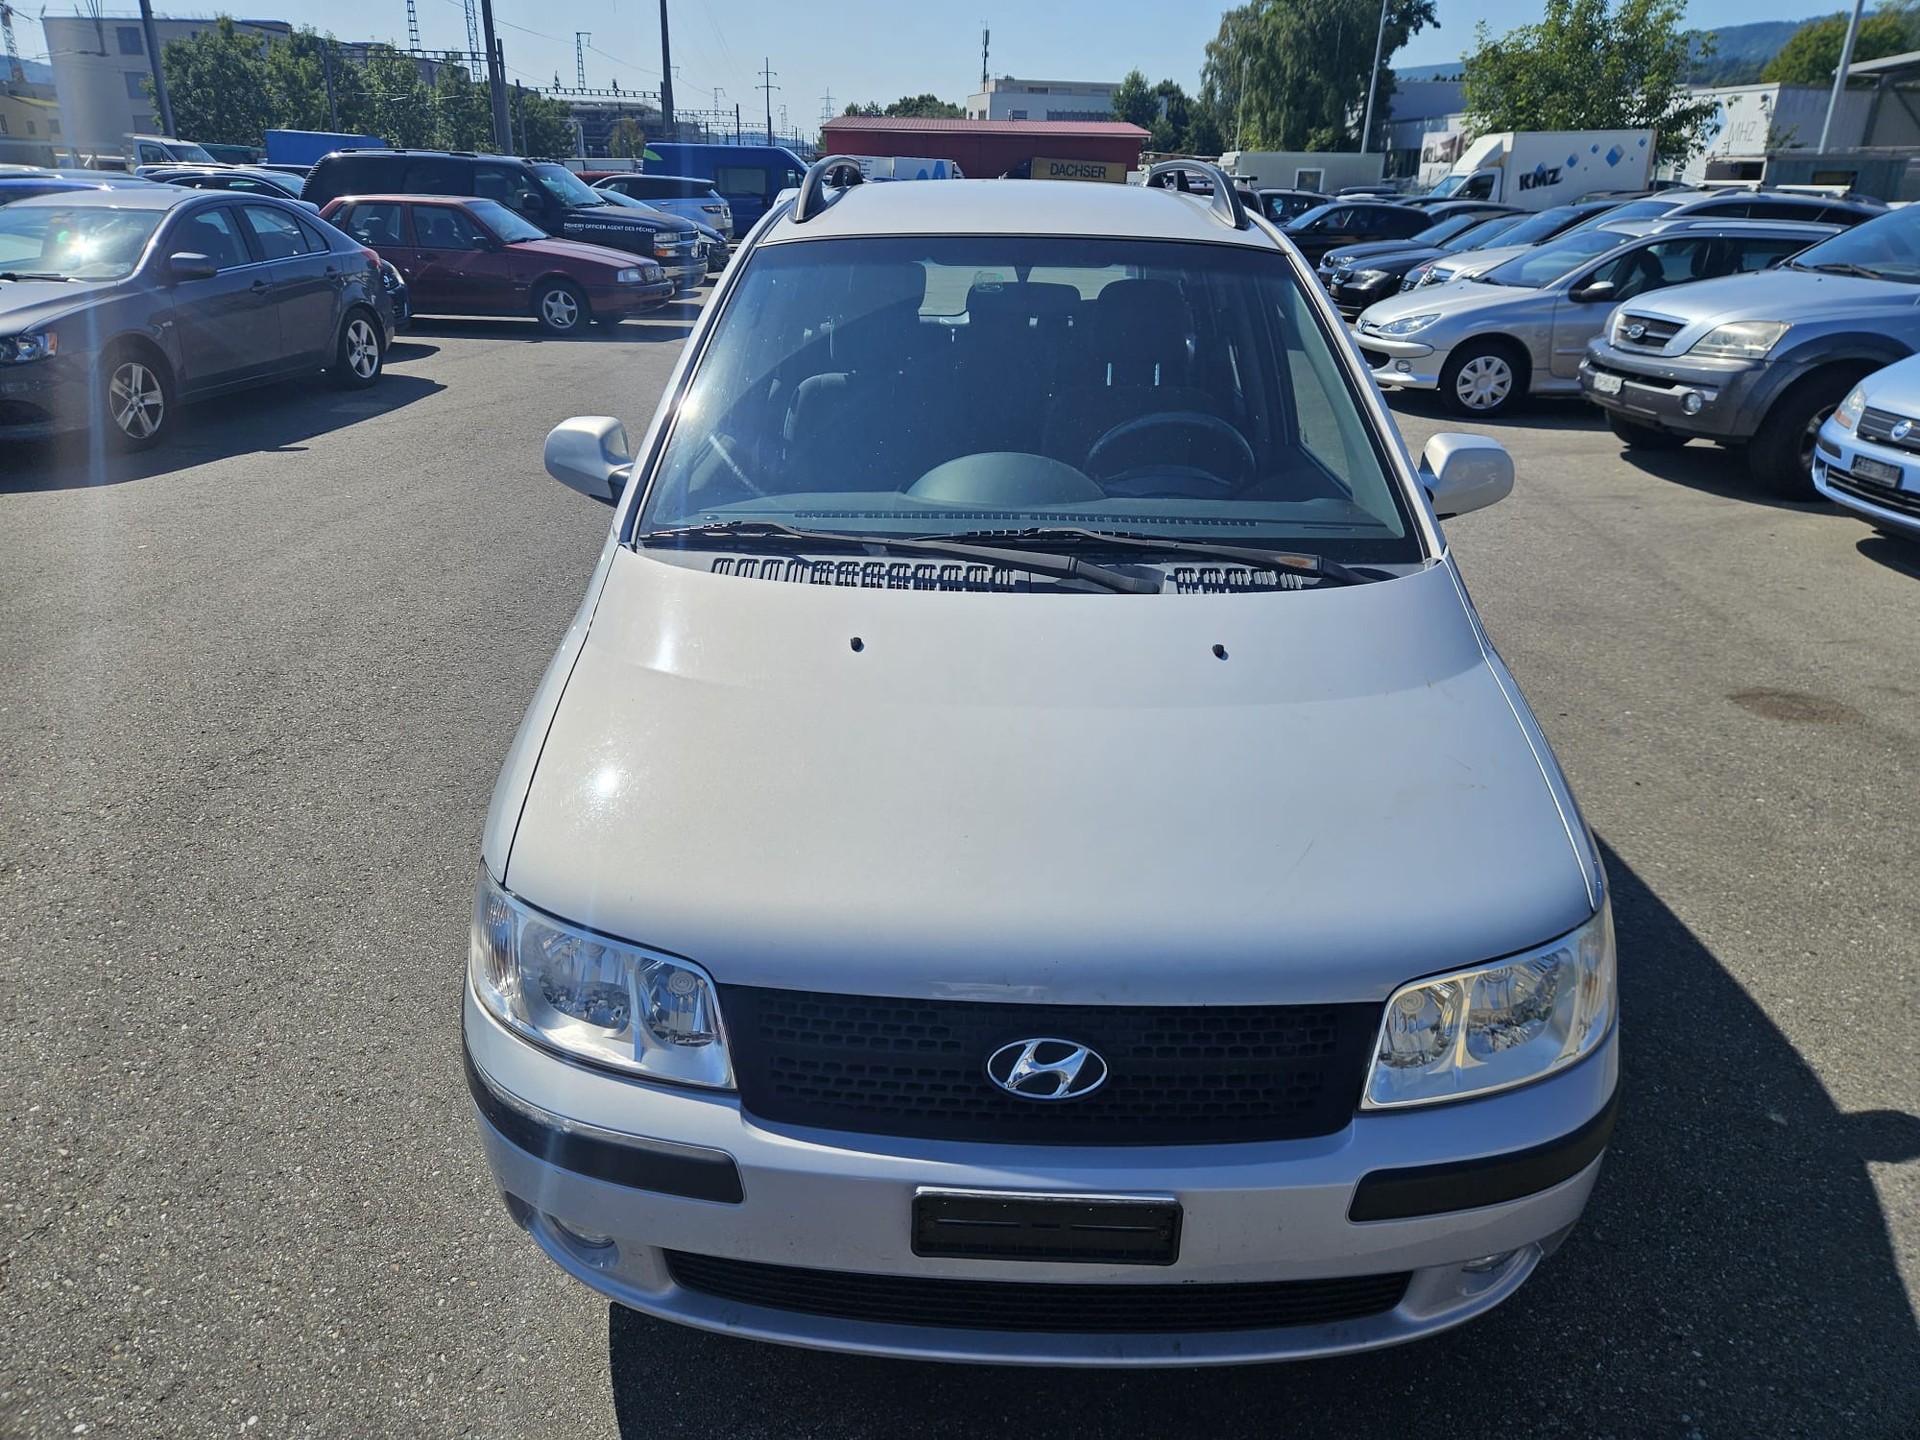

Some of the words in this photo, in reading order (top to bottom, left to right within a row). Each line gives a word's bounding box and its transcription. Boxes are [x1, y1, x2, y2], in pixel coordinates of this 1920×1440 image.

[1729, 121, 1757, 141] MHZ
[1050, 163, 1106, 179] DACHSER
[1519, 166, 1563, 191] KMZ
